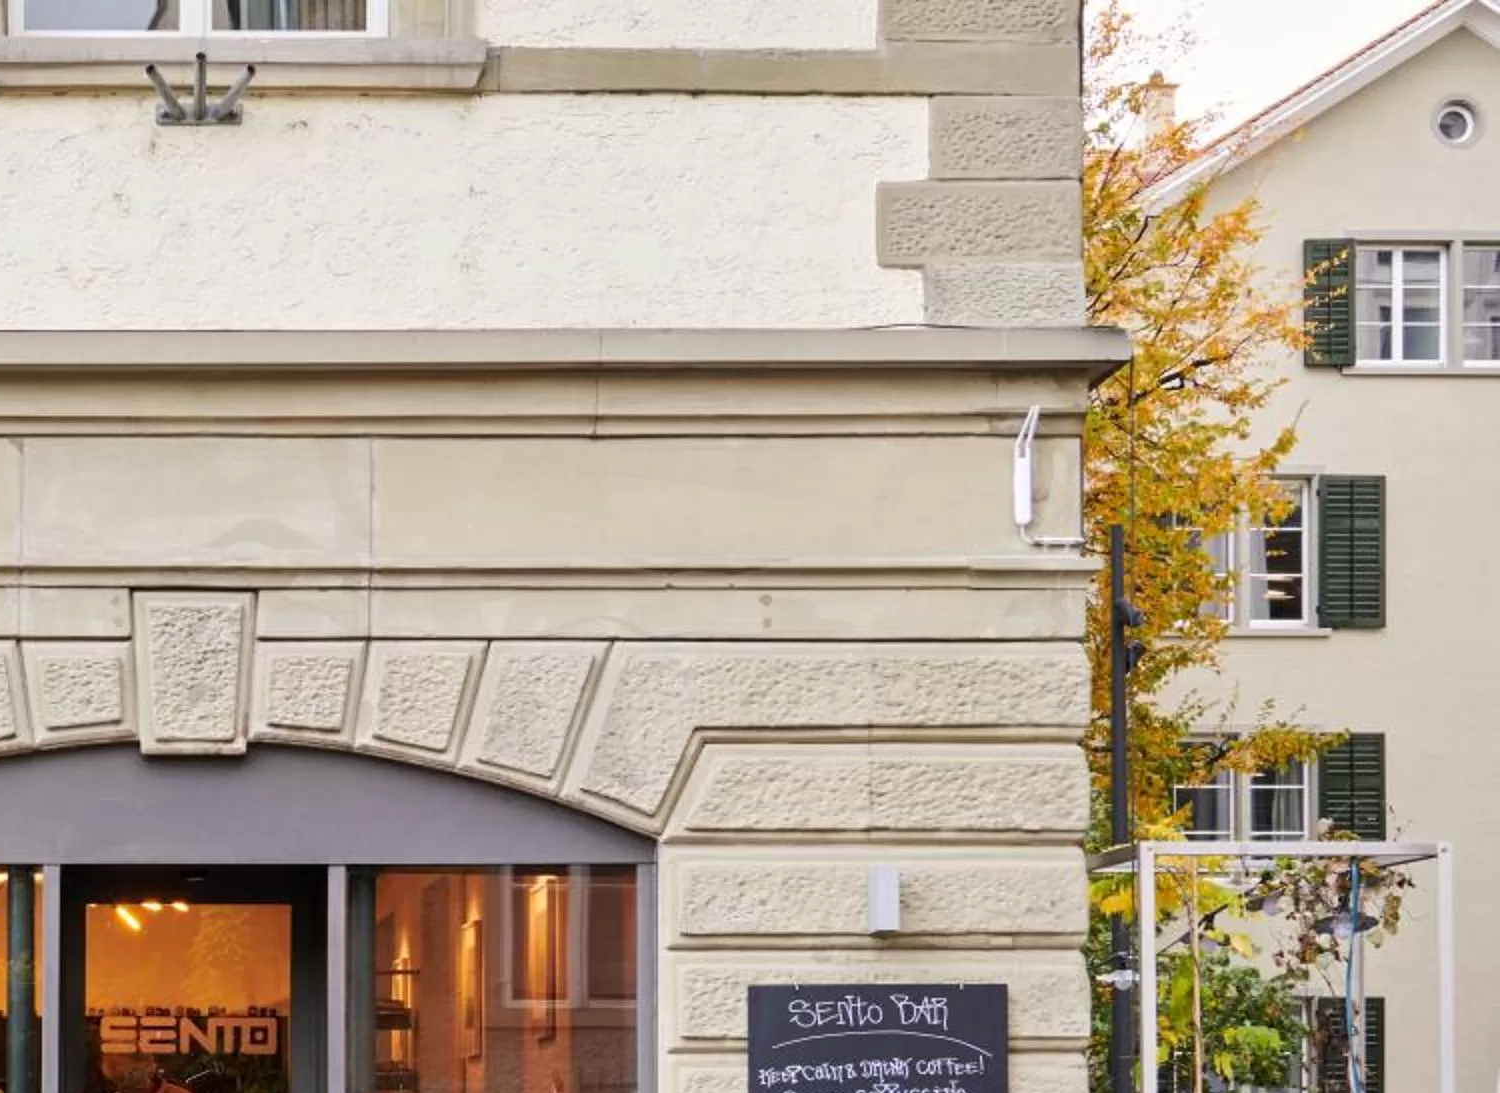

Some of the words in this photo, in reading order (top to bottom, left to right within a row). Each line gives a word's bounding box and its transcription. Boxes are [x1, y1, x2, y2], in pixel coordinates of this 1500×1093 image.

[788, 994, 884, 1028] SENTO
[889, 993, 949, 1031] BAR
[100, 1016, 278, 1055] SENTO
